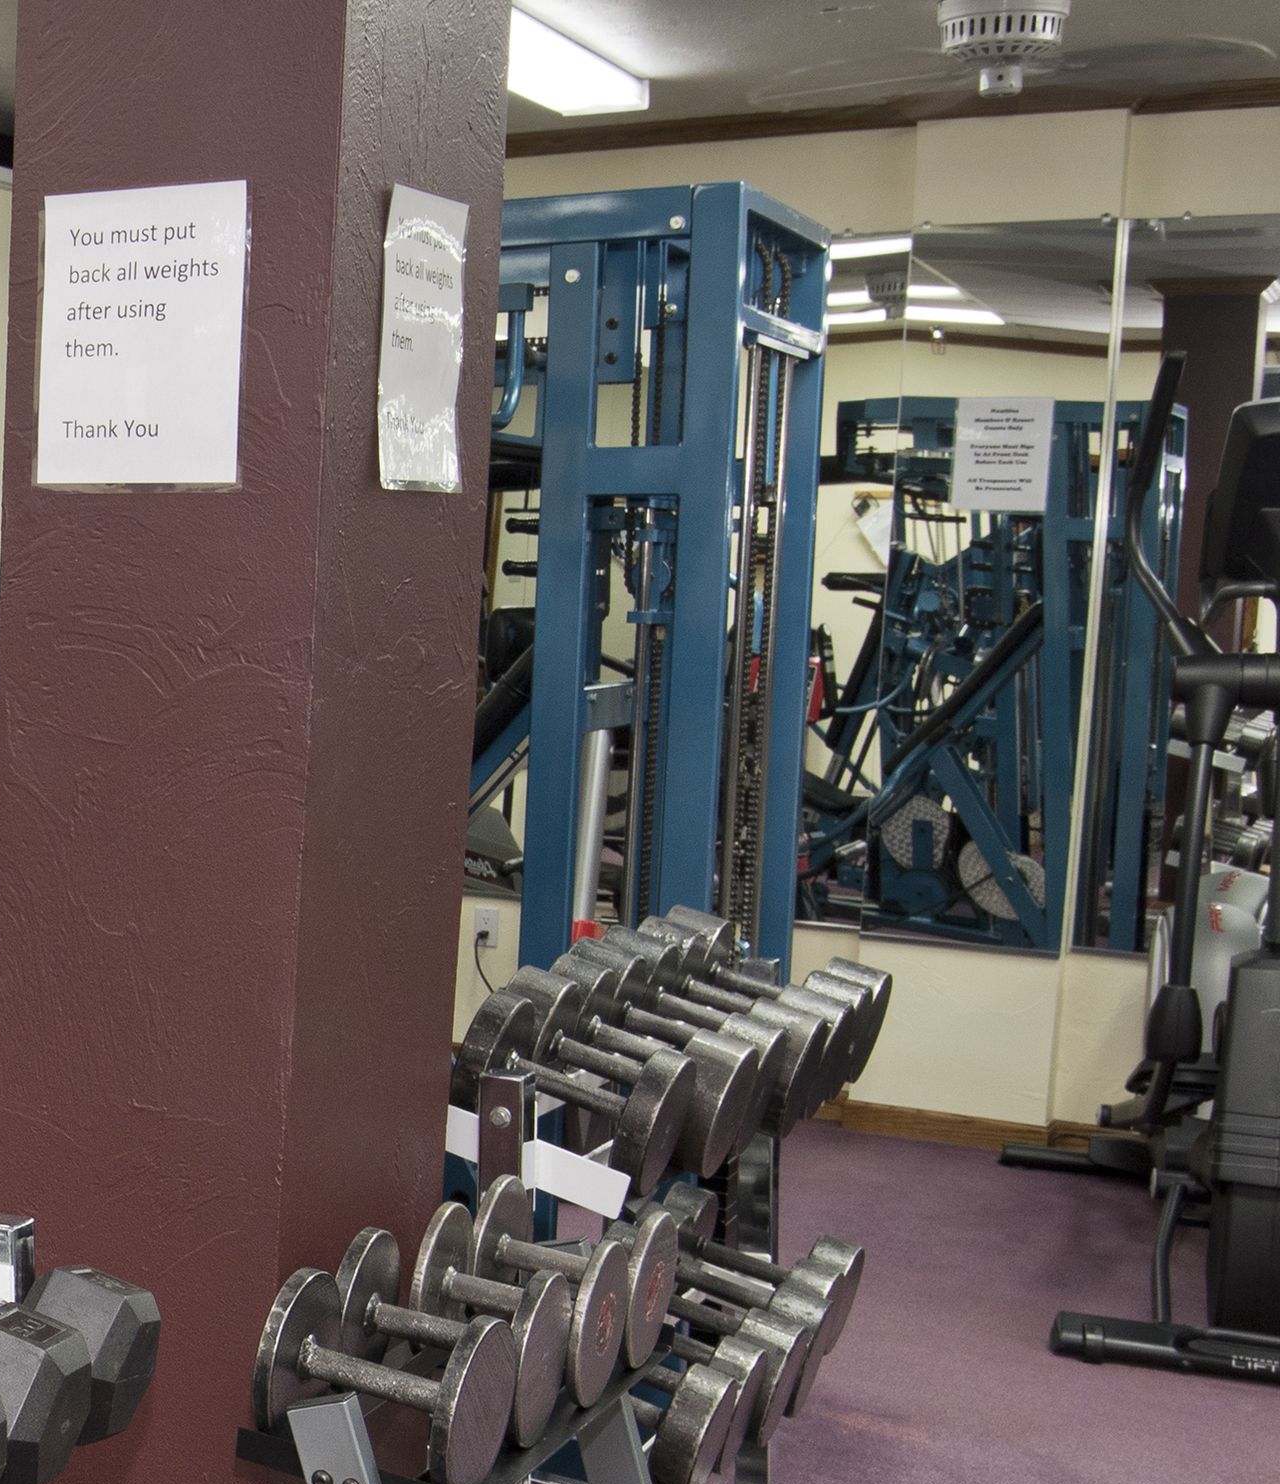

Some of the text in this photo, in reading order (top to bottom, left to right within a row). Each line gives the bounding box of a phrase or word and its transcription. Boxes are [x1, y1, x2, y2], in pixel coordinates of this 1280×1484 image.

[70, 222, 196, 247] You must put
[69, 257, 219, 284] back all weights
[395, 253, 454, 290] back all weights
[66, 300, 167, 321] after using
[65, 338, 119, 358] them.
[391, 329, 415, 352] them.
[62, 419, 159, 438] Thank You
[410, 415, 425, 435] You
